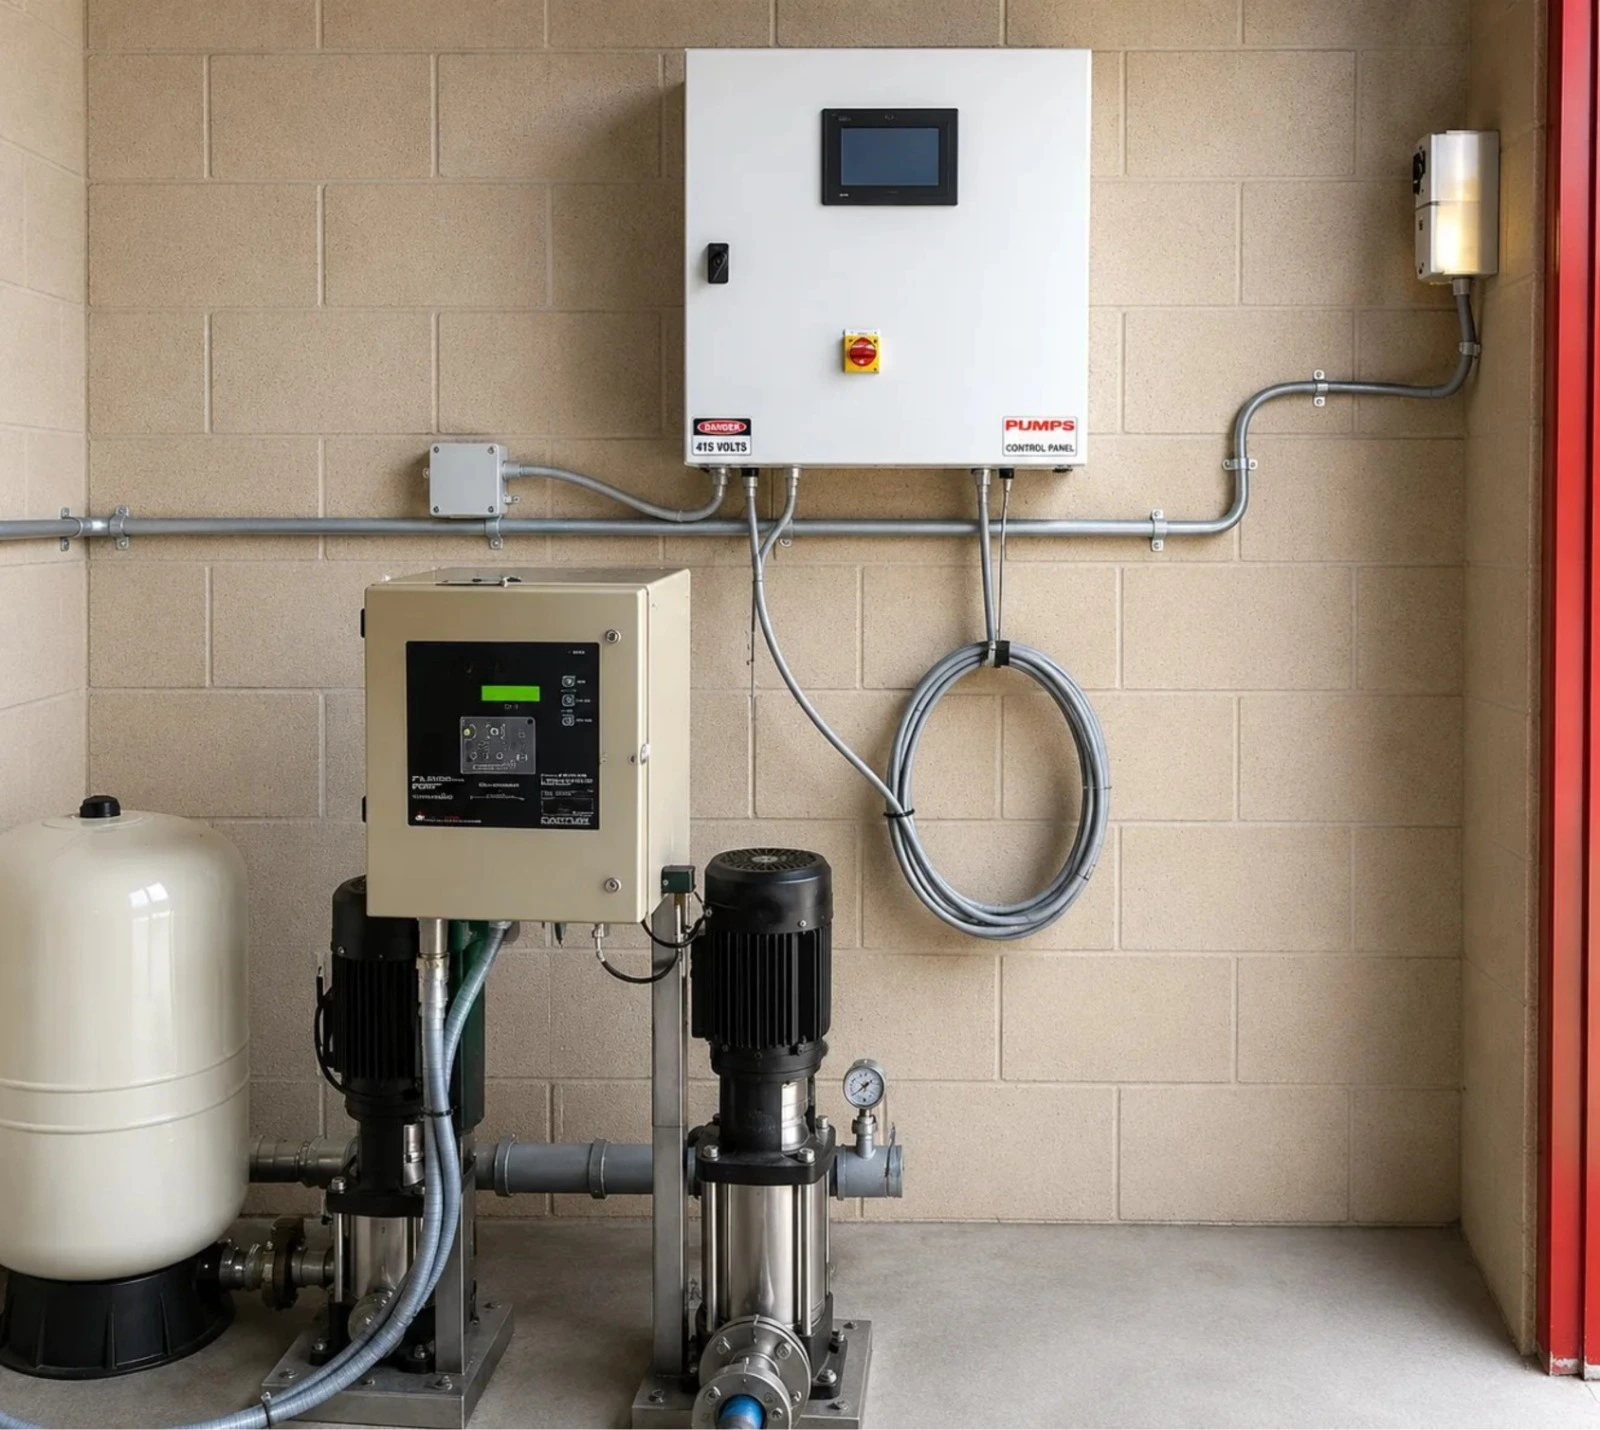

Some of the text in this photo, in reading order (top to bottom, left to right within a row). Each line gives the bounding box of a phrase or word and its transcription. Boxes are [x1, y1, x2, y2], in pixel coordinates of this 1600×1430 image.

[704, 423, 740, 432] DANGER
[1005, 419, 1075, 431] PUMPS
[716, 441, 748, 452] VOLTS
[1005, 443, 1075, 453] CONTROL PANEL
